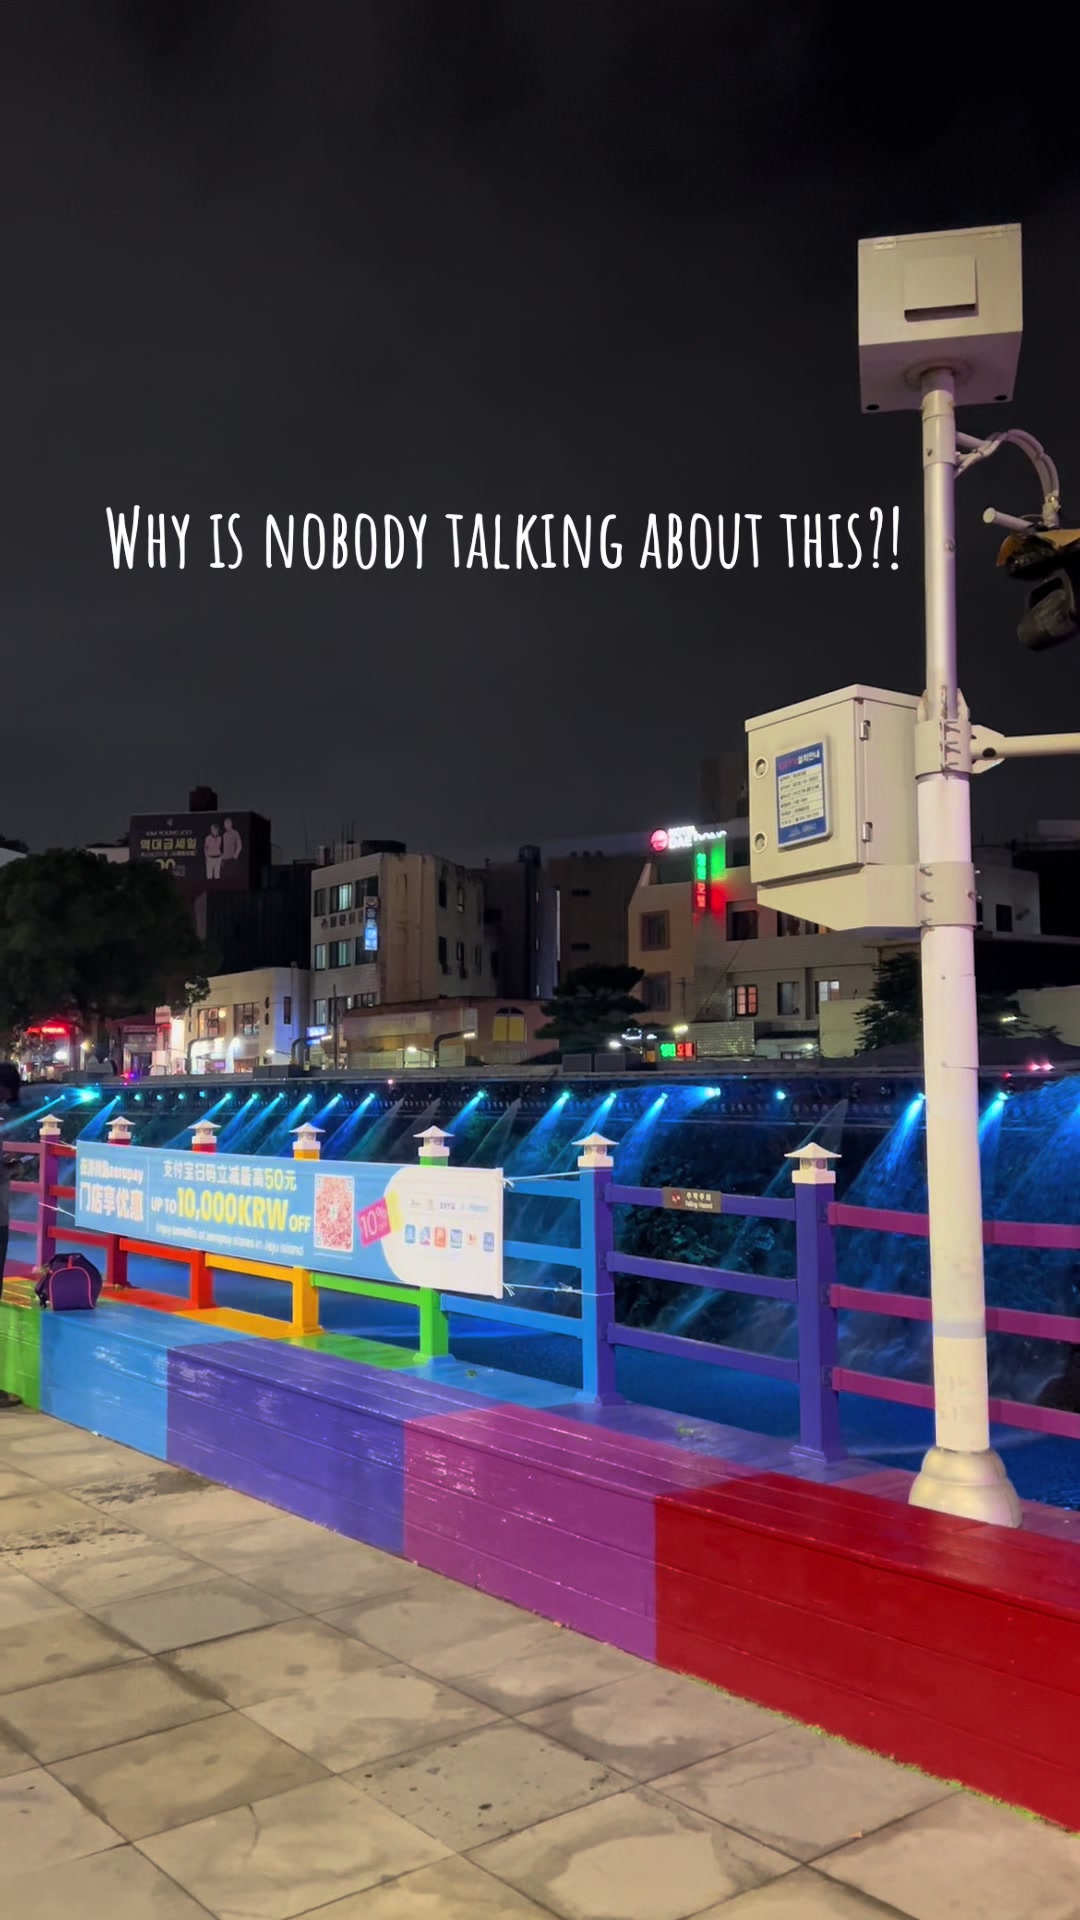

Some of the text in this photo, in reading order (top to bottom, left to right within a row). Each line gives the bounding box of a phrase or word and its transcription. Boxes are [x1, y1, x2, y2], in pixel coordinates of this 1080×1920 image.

[140, 838, 197, 851] 역대급세일
[162, 1159, 297, 1191] 支付宝扫码立减最高50元
[151, 1187, 312, 1234] UP TO 10,000KRW OFF
[360, 1207, 388, 1240] 10%
